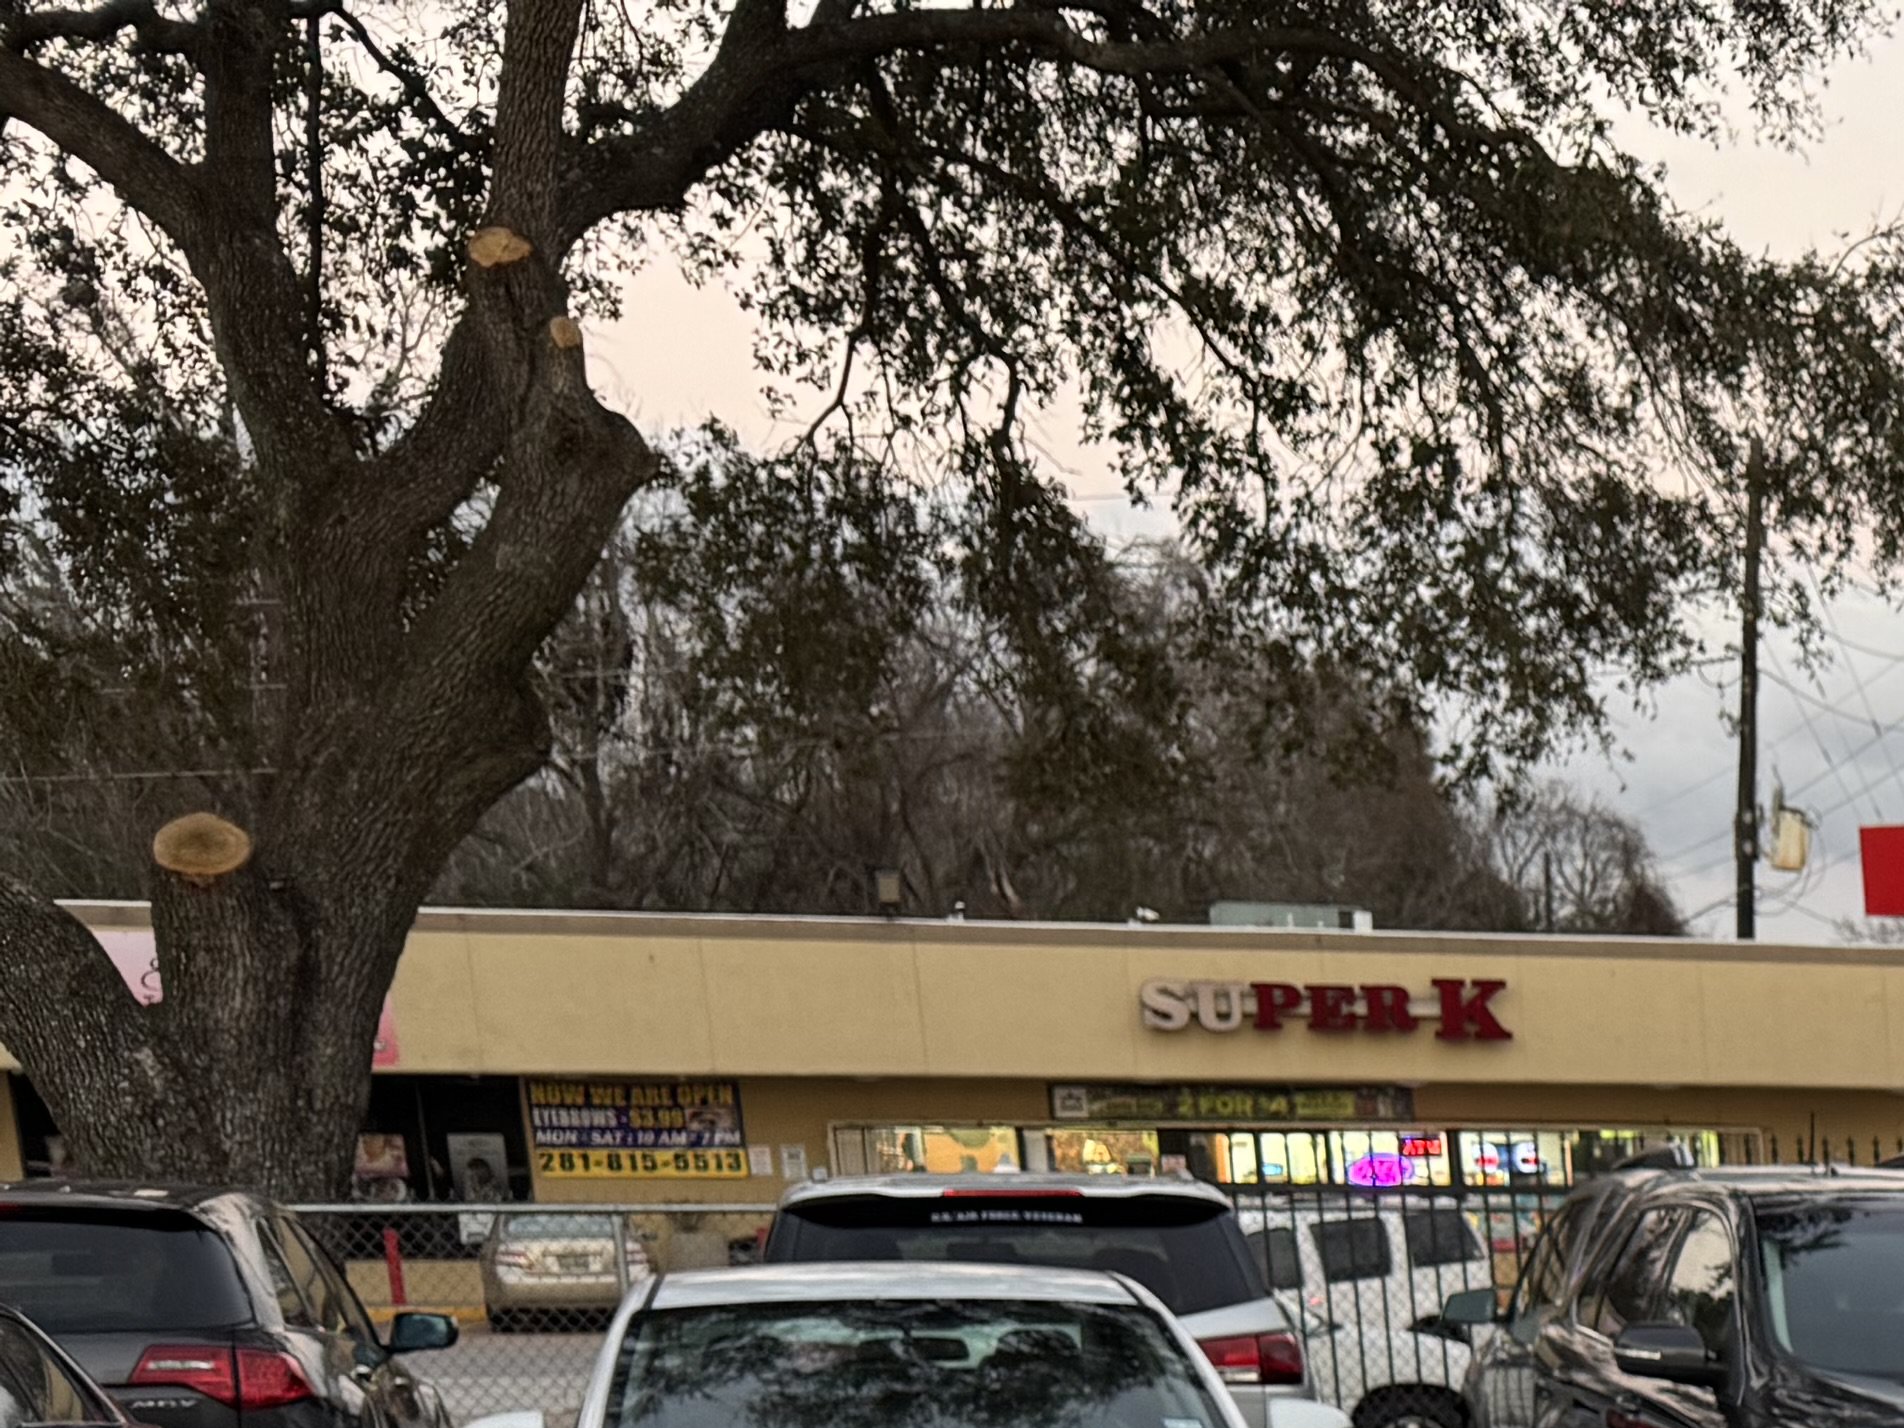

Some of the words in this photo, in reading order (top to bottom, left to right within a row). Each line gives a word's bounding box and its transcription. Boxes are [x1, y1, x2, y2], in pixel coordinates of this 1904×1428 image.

[1140, 976, 1419, 1031] SUPER
[1431, 978, 1513, 1042] K
[530, 1081, 585, 1105] NOW
[590, 1082, 627, 1106] WE
[631, 1083, 673, 1106] ARE
[677, 1083, 733, 1106] OPEN
[531, 1106, 619, 1128] EYEBROWS
[535, 1128, 579, 1146] MON
[589, 1129, 625, 1146] SAT
[657, 1129, 687, 1146] AM
[714, 1129, 741, 1146] PM
